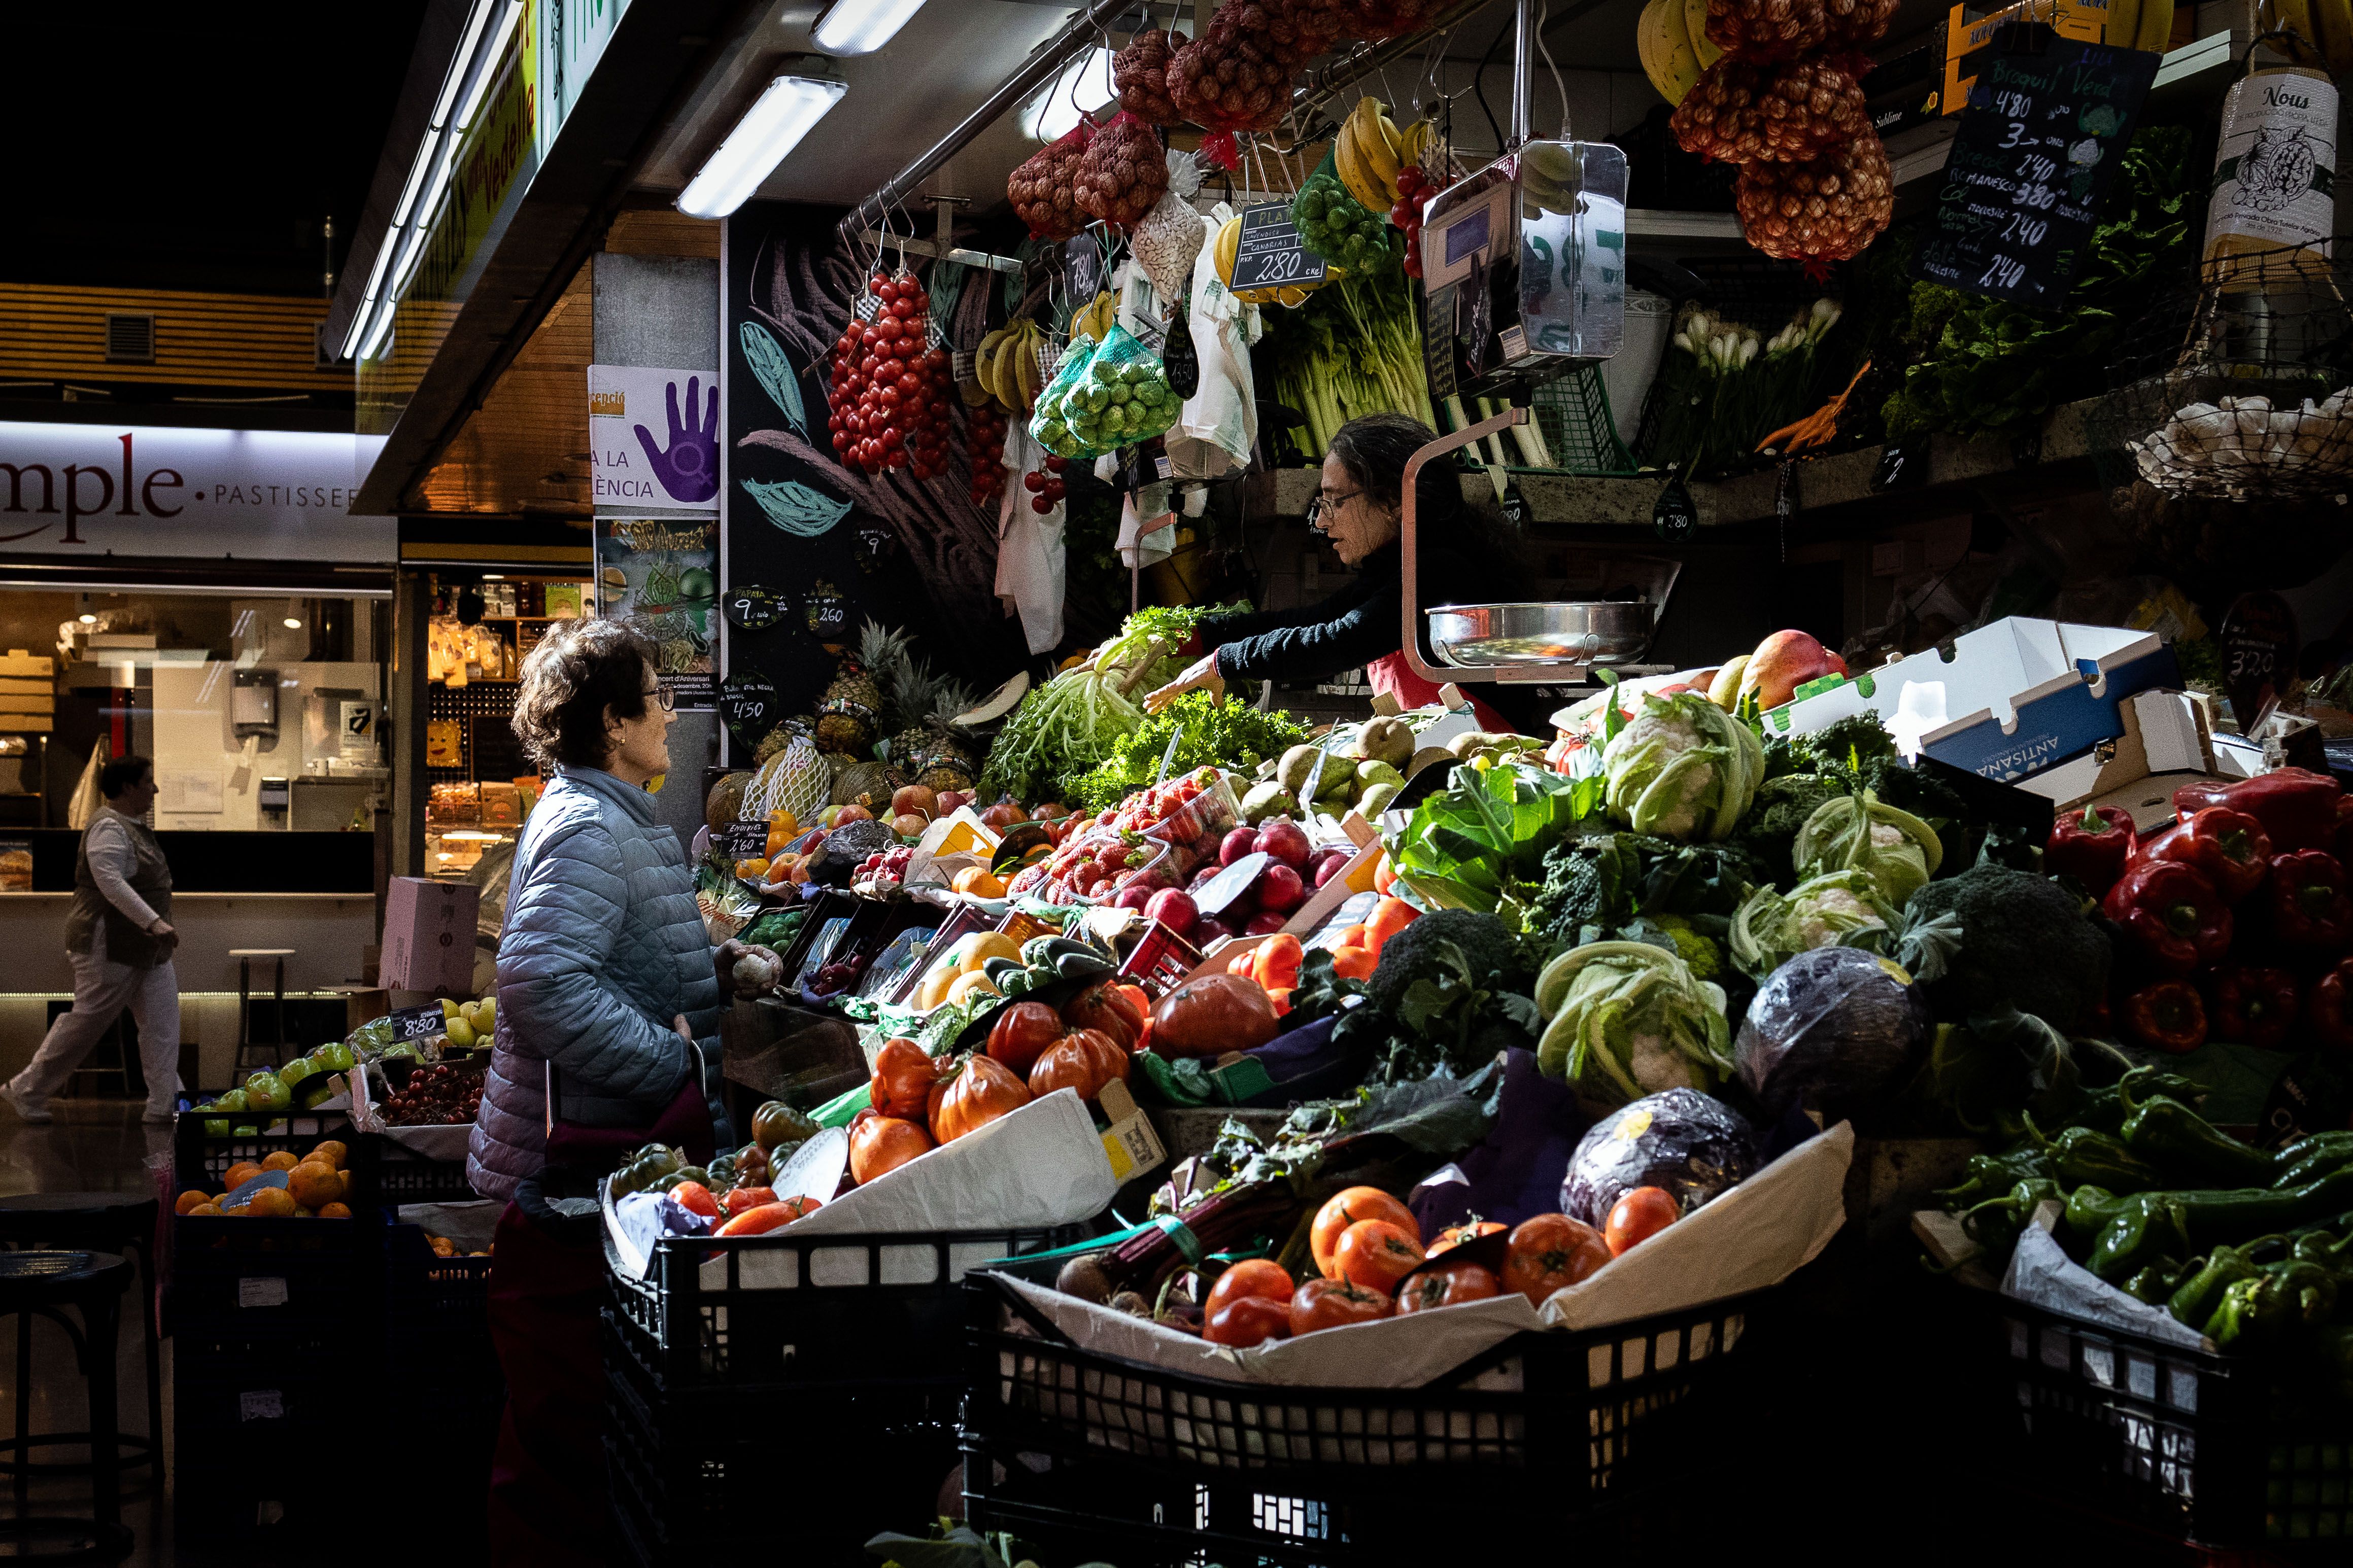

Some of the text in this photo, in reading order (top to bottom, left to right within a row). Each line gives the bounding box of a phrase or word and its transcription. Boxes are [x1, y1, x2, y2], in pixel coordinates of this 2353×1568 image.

[1996, 90, 2032, 118] 4'80
[2262, 84, 2310, 110] Nous
[1875, 111, 1903, 129] Sublime
[1998, 122, 2025, 149] 3
[2000, 212, 2049, 247] 2'40
[2261, 216, 2278, 226] Obra
[1255, 251, 1301, 282] 2'80
[1979, 254, 2026, 289] 2'40
[607, 450, 629, 468] LA
[1884, 457, 1904, 485] 2
[592, 474, 654, 498] ÈNCIA
[1667, 514, 1688, 528] 2'80
[868, 538, 879, 555] 9
[734, 599, 752, 619] 9
[733, 702, 764, 719] 4'50
[1975, 736, 2059, 777] ANTISANA
[729, 824, 762, 832] ENDIVIES
[729, 839, 755, 852] 2'60
[405, 1017, 437, 1036] 8'80
